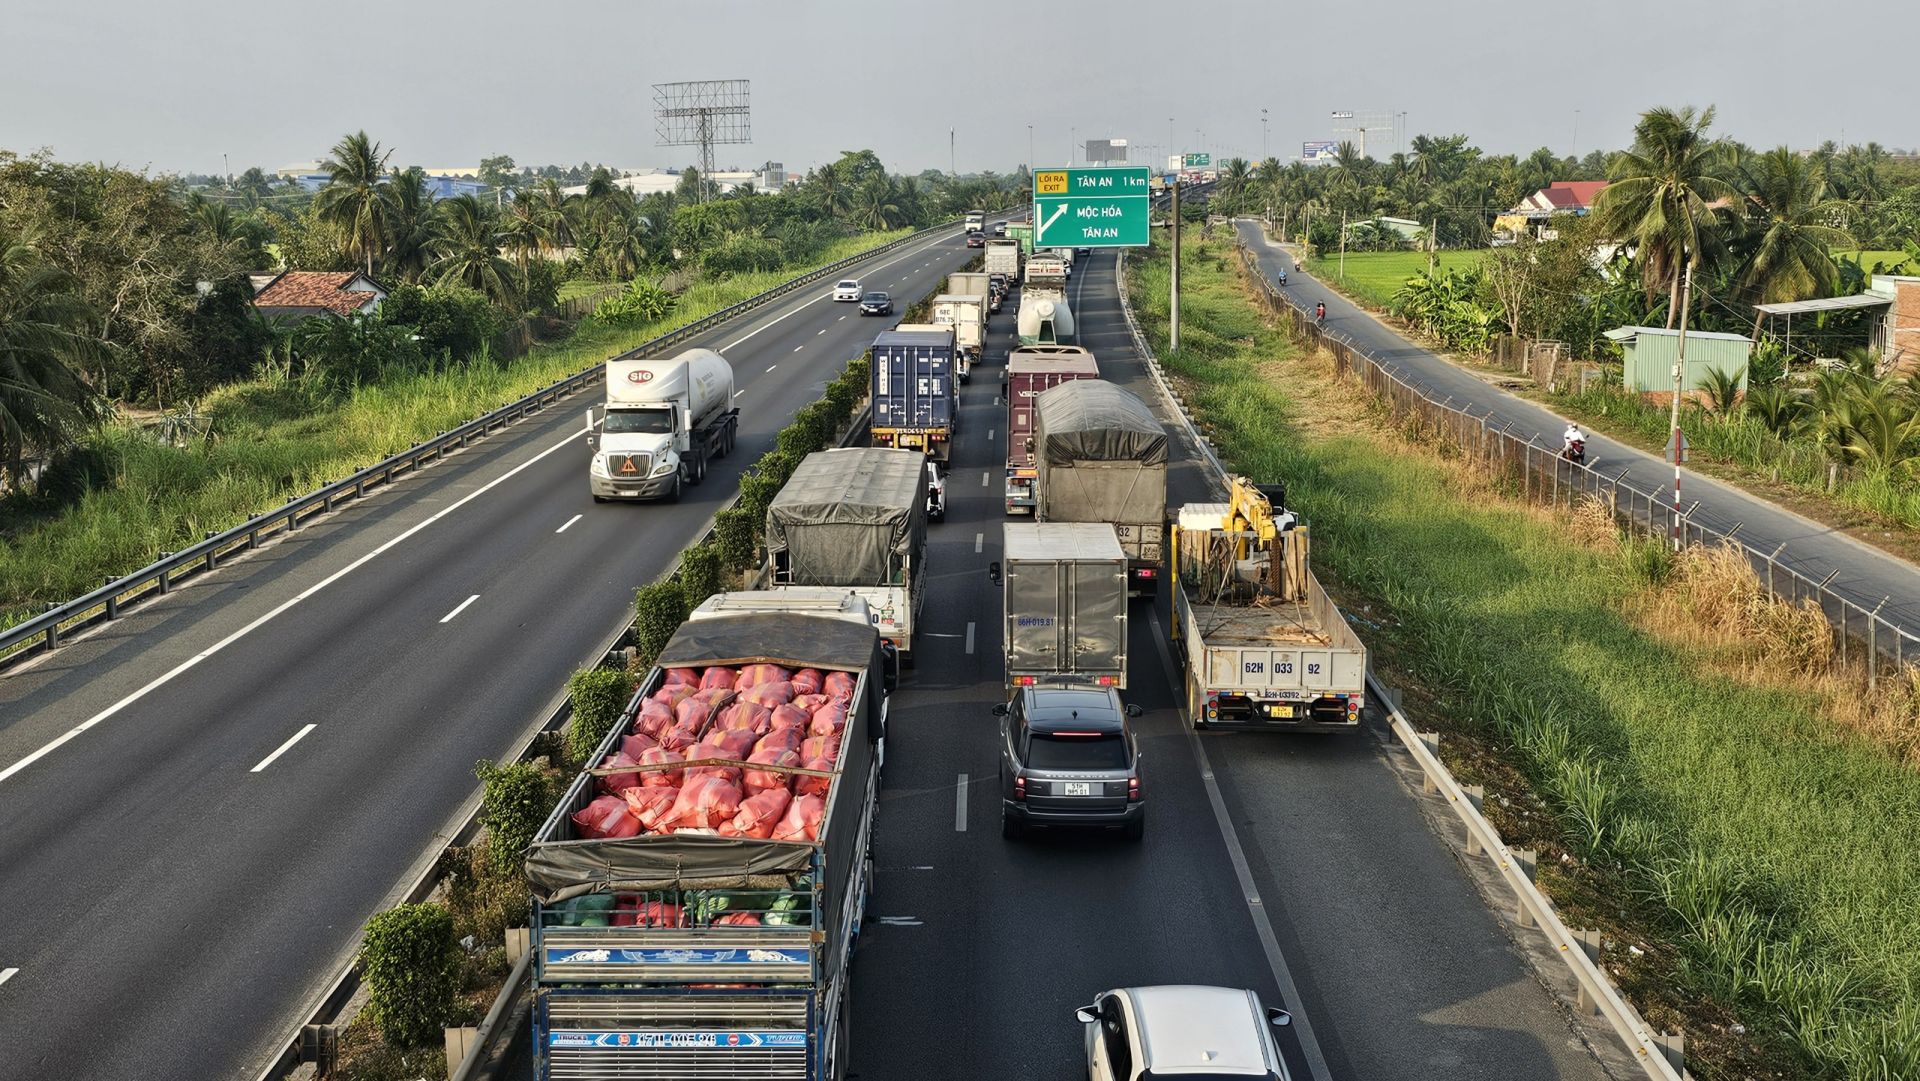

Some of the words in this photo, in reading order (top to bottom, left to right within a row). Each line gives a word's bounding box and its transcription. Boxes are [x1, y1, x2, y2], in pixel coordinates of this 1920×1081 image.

[1077, 175, 1096, 187] TÂN
[1098, 177, 1113, 187] AN
[1123, 176, 1127, 186] 1
[1130, 177, 1145, 186] km
[1077, 205, 1099, 219] MỘC
[1101, 203, 1123, 217] HÓA
[1082, 226, 1102, 238] TÂN
[1103, 228, 1118, 237] AN
[1245, 662, 1264, 673] 62H
[1274, 663, 1293, 674] 033
[1308, 663, 1320, 674] 92
